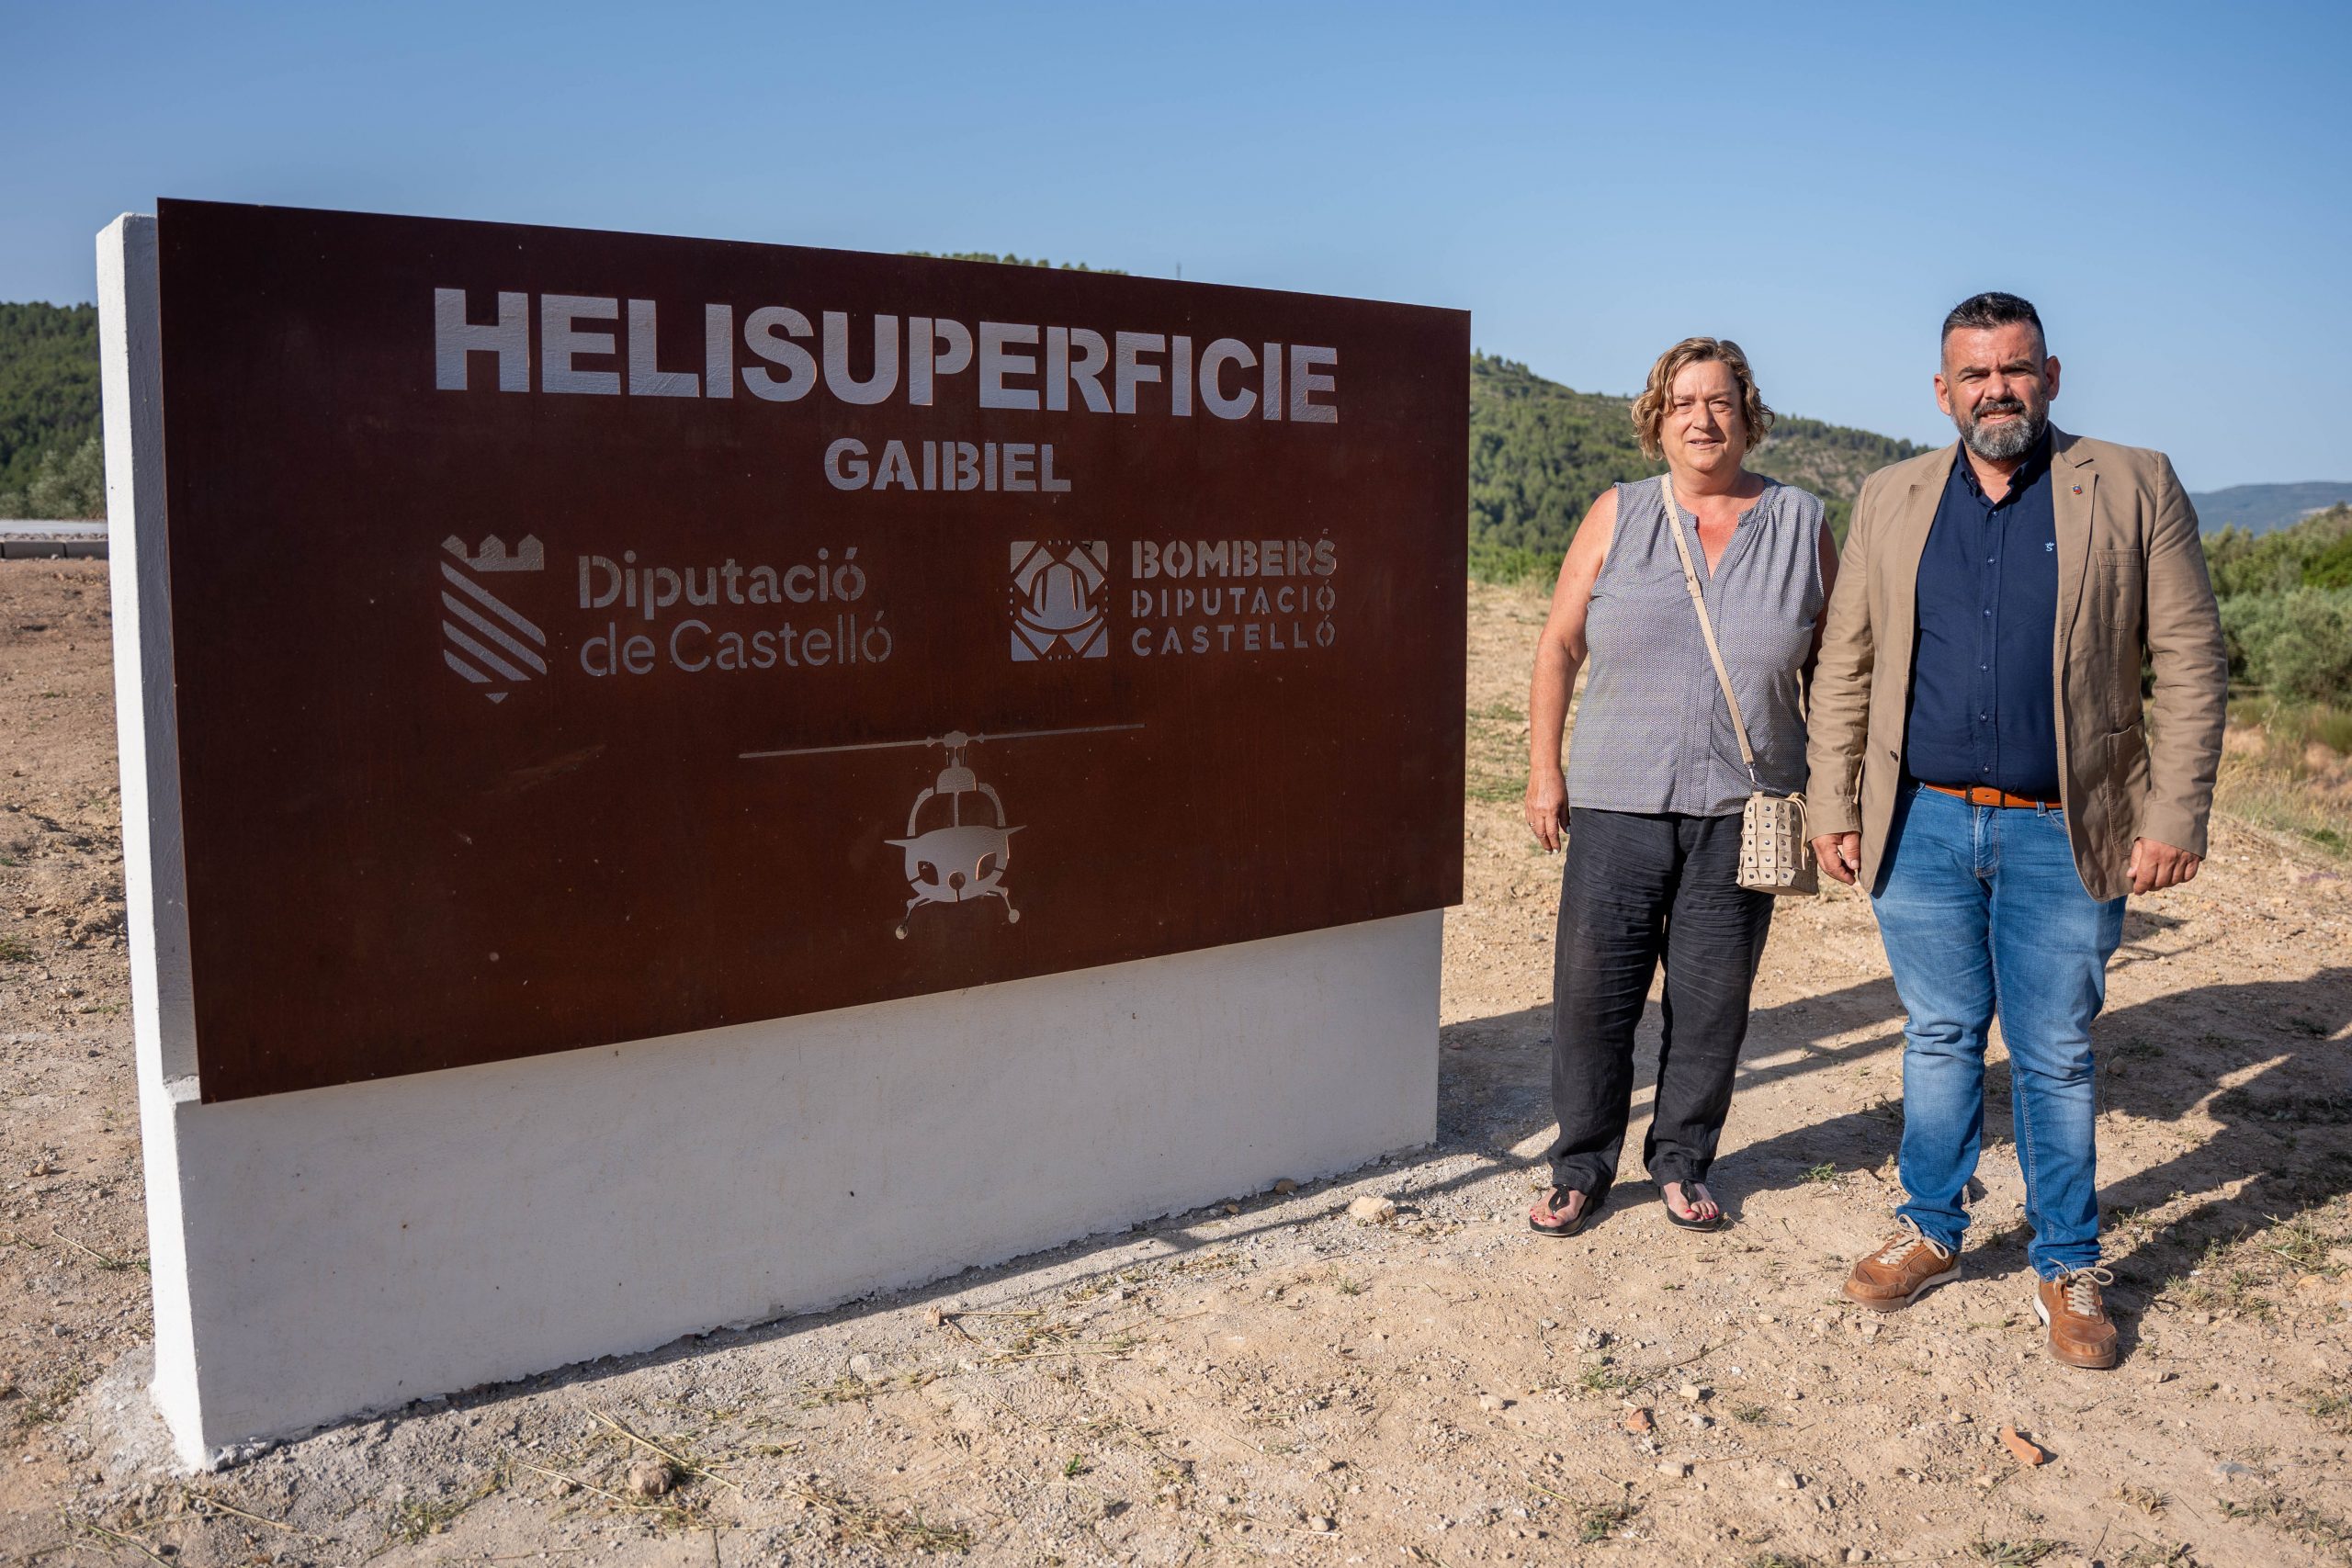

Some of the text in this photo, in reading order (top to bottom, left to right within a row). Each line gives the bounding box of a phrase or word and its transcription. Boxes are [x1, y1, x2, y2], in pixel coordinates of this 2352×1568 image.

[435, 288, 1338, 423] HELISUPERFICIE
[824, 438, 1071, 492] GAIBIEL
[579, 547, 866, 620] Diputació
[1132, 540, 1337, 579] BOMBERS
[1132, 579, 1336, 618] DIPUTACIÓ
[580, 611, 893, 676] de Castelló
[1132, 615, 1336, 657] CASTELLÓ
